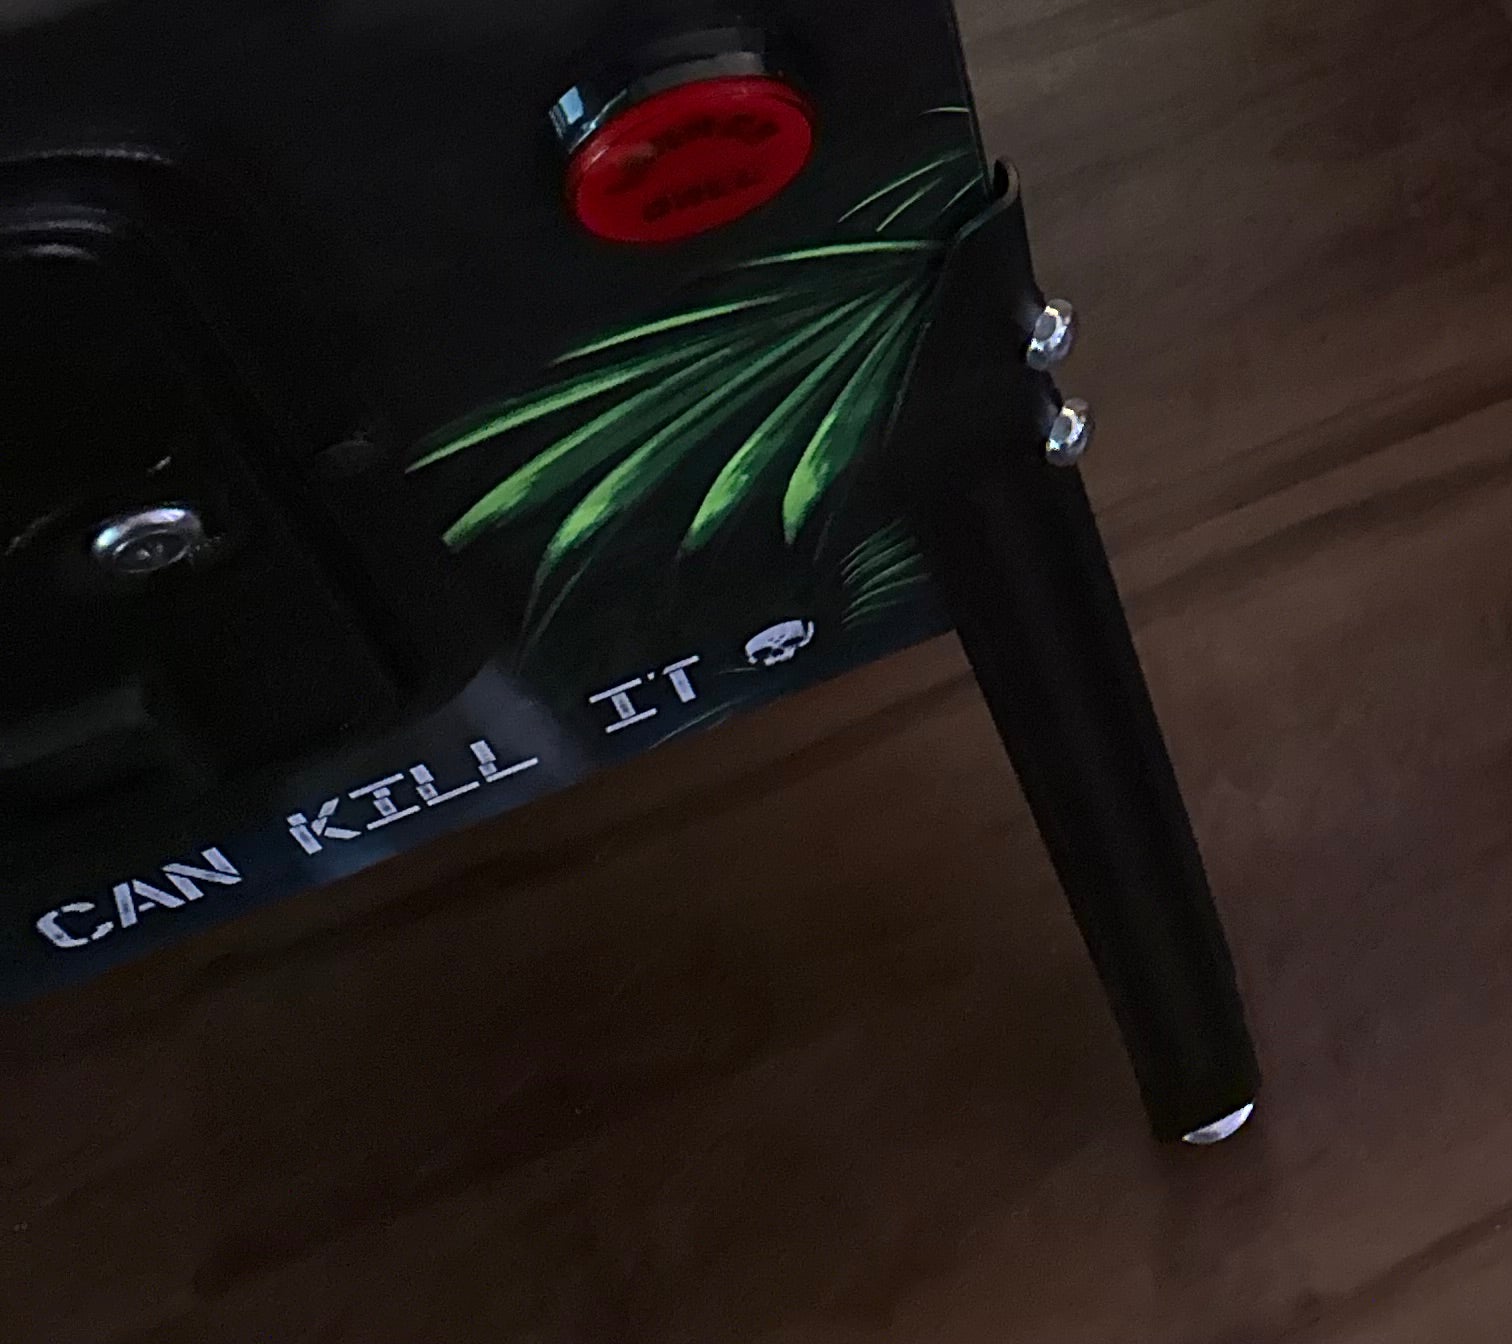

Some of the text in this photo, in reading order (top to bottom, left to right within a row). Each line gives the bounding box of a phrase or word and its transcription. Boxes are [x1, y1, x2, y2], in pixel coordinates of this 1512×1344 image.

[36, 655, 699, 949] CAN KILL IT
